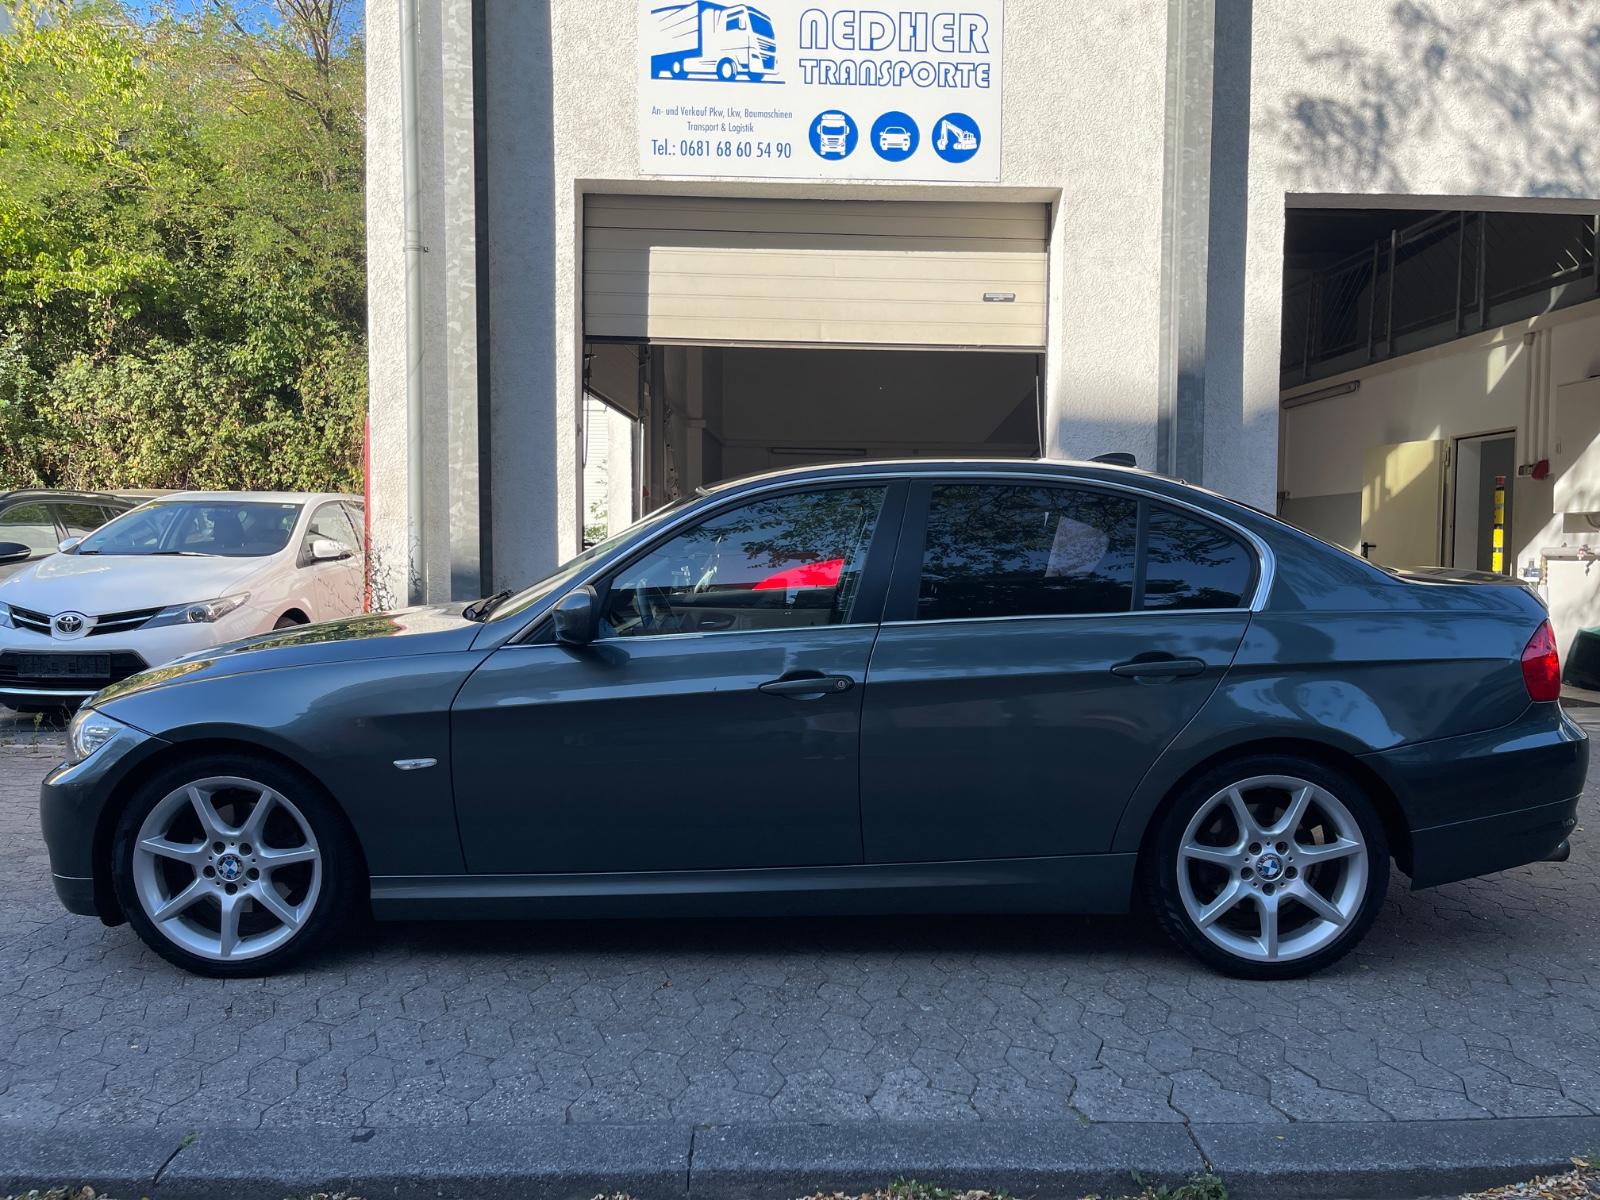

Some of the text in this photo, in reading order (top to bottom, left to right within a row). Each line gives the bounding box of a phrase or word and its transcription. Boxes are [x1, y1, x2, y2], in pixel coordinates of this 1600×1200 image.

[799, 8, 990, 54] NEDHER
[799, 58, 990, 89] TRANSPORTE
[651, 105, 793, 119] An- und Verkauf Pkw, Lkw, Baumaschinen
[687, 121, 754, 134] Transport & Logistik
[651, 138, 792, 159] Tel.: 0681 68 60 54 90
